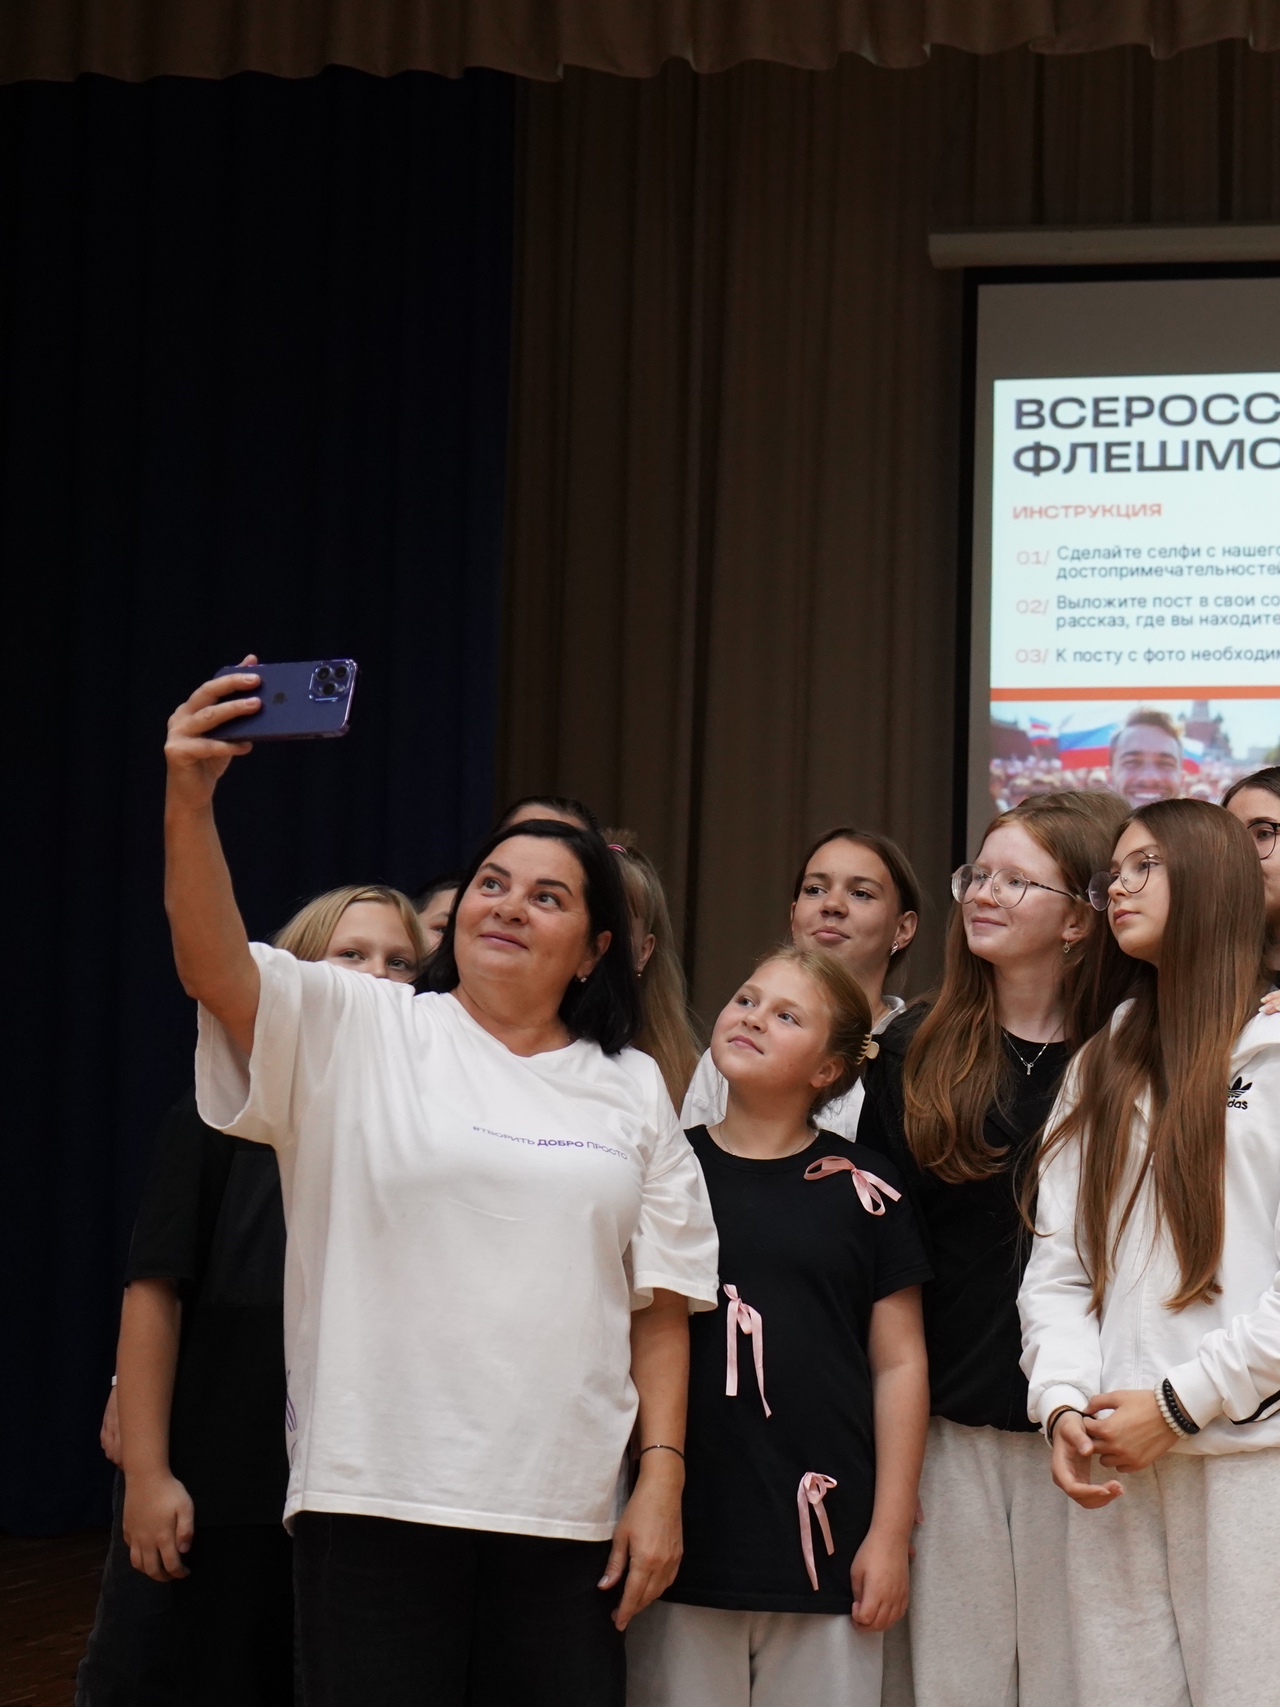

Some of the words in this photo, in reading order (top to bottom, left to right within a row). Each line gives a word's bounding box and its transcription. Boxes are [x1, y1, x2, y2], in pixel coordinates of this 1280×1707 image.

[1013, 503, 1162, 519] ИНСТРУКЦИЯ
[1057, 545, 1142, 561] Сделайте
[1147, 545, 1201, 560] селфи
[1206, 548, 1216, 558] с
[1057, 595, 1147, 610] Выложите
[1152, 595, 1193, 608] пост
[1199, 595, 1208, 607] в
[1214, 595, 1256, 607] свои
[1057, 613, 1130, 630] рассказ,
[1136, 613, 1165, 627] где
[1171, 612, 1194, 626] вы
[1056, 649, 1067, 662] К
[1073, 650, 1123, 665] посту
[1128, 651, 1138, 661] с
[1143, 646, 1186, 664] фото
[1227, 1099, 1248, 1110] das
[537, 1139, 584, 1148] ДОБРО
